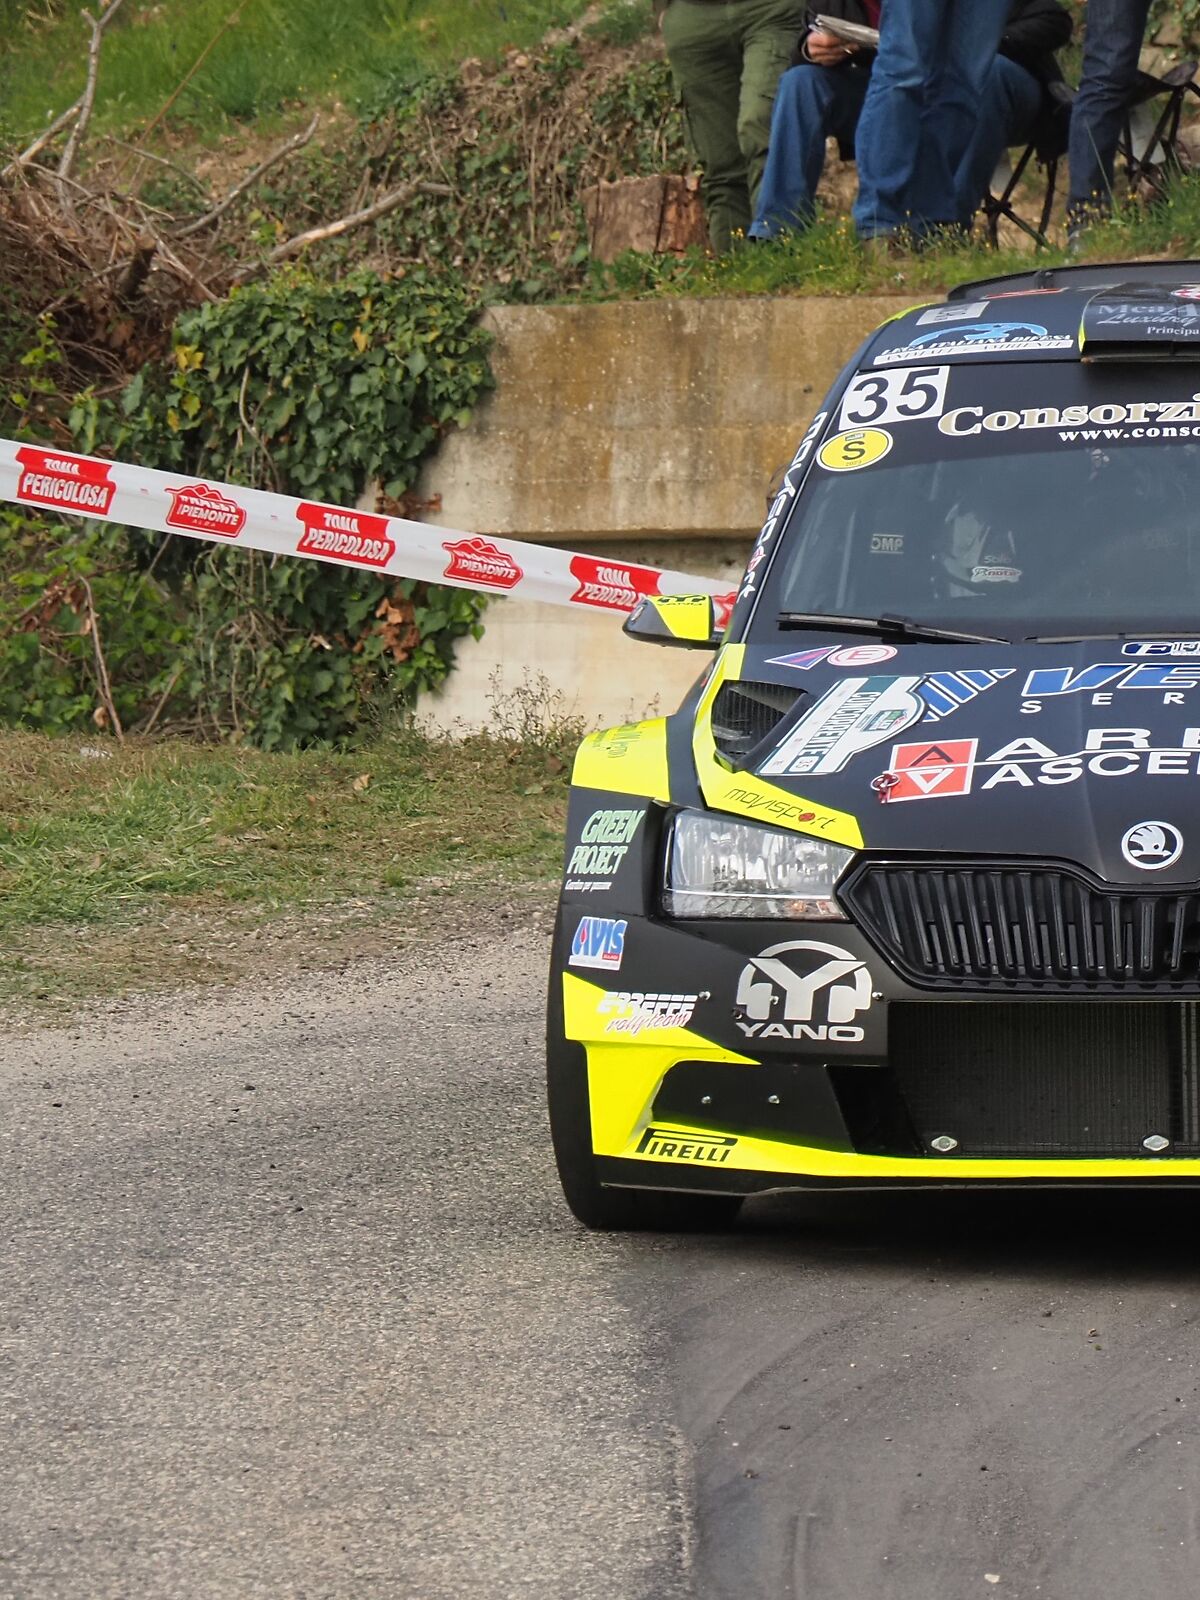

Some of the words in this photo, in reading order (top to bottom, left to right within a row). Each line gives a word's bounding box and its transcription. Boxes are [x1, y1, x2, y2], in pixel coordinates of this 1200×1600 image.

[1097, 313, 1198, 327] Luxury
[847, 367, 940, 424] 35
[842, 441, 866, 461] S
[22, 472, 110, 509] PERICOLOSA
[303, 527, 391, 561] PERICOLOSA
[800, 691, 881, 760] CONCORRENTE
[723, 786, 838, 830] movisport
[581, 810, 646, 843] GREEN
[566, 845, 629, 875] PROJECT
[572, 916, 628, 958] AVIS
[736, 1022, 865, 1042] YANO
[635, 1126, 738, 1163] PIRELLI
